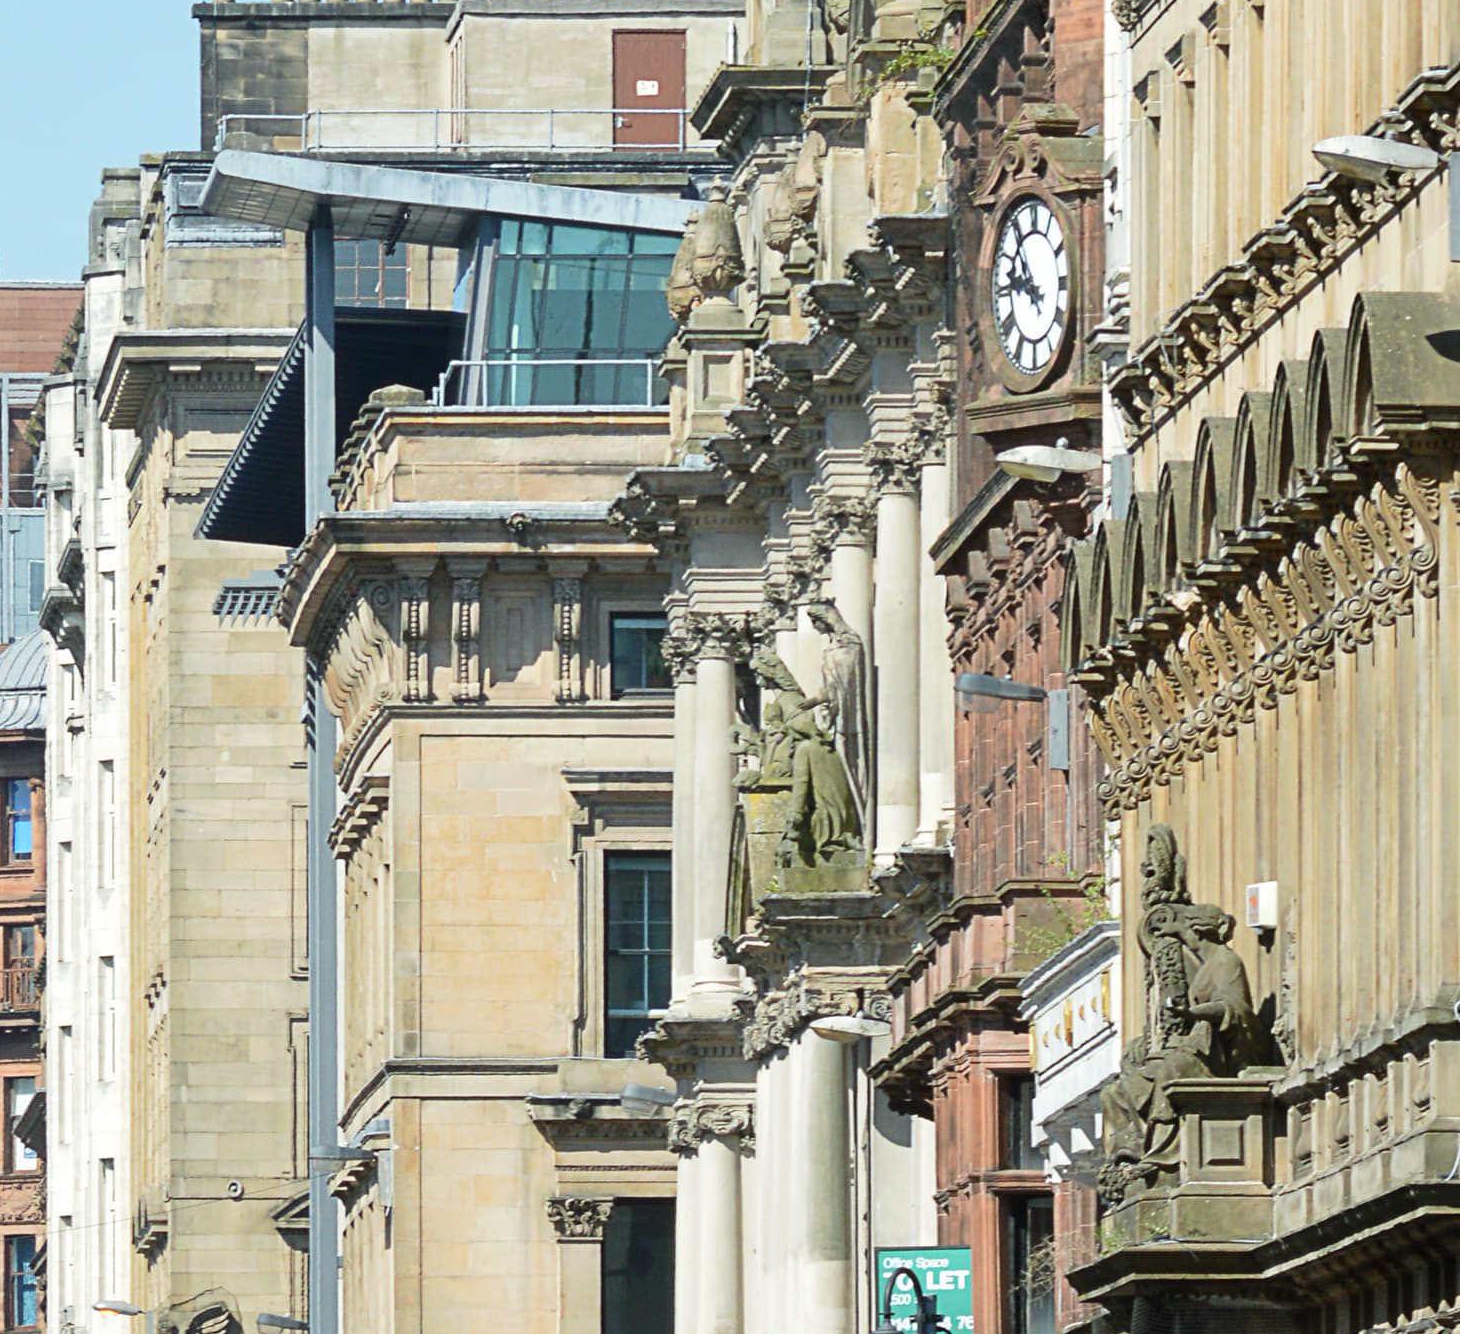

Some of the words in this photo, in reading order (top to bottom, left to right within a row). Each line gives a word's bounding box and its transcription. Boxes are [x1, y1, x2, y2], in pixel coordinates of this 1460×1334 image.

[883, 1257, 913, 1268] Office
[916, 1257, 949, 1269] Space
[926, 1270, 970, 1290] LET
